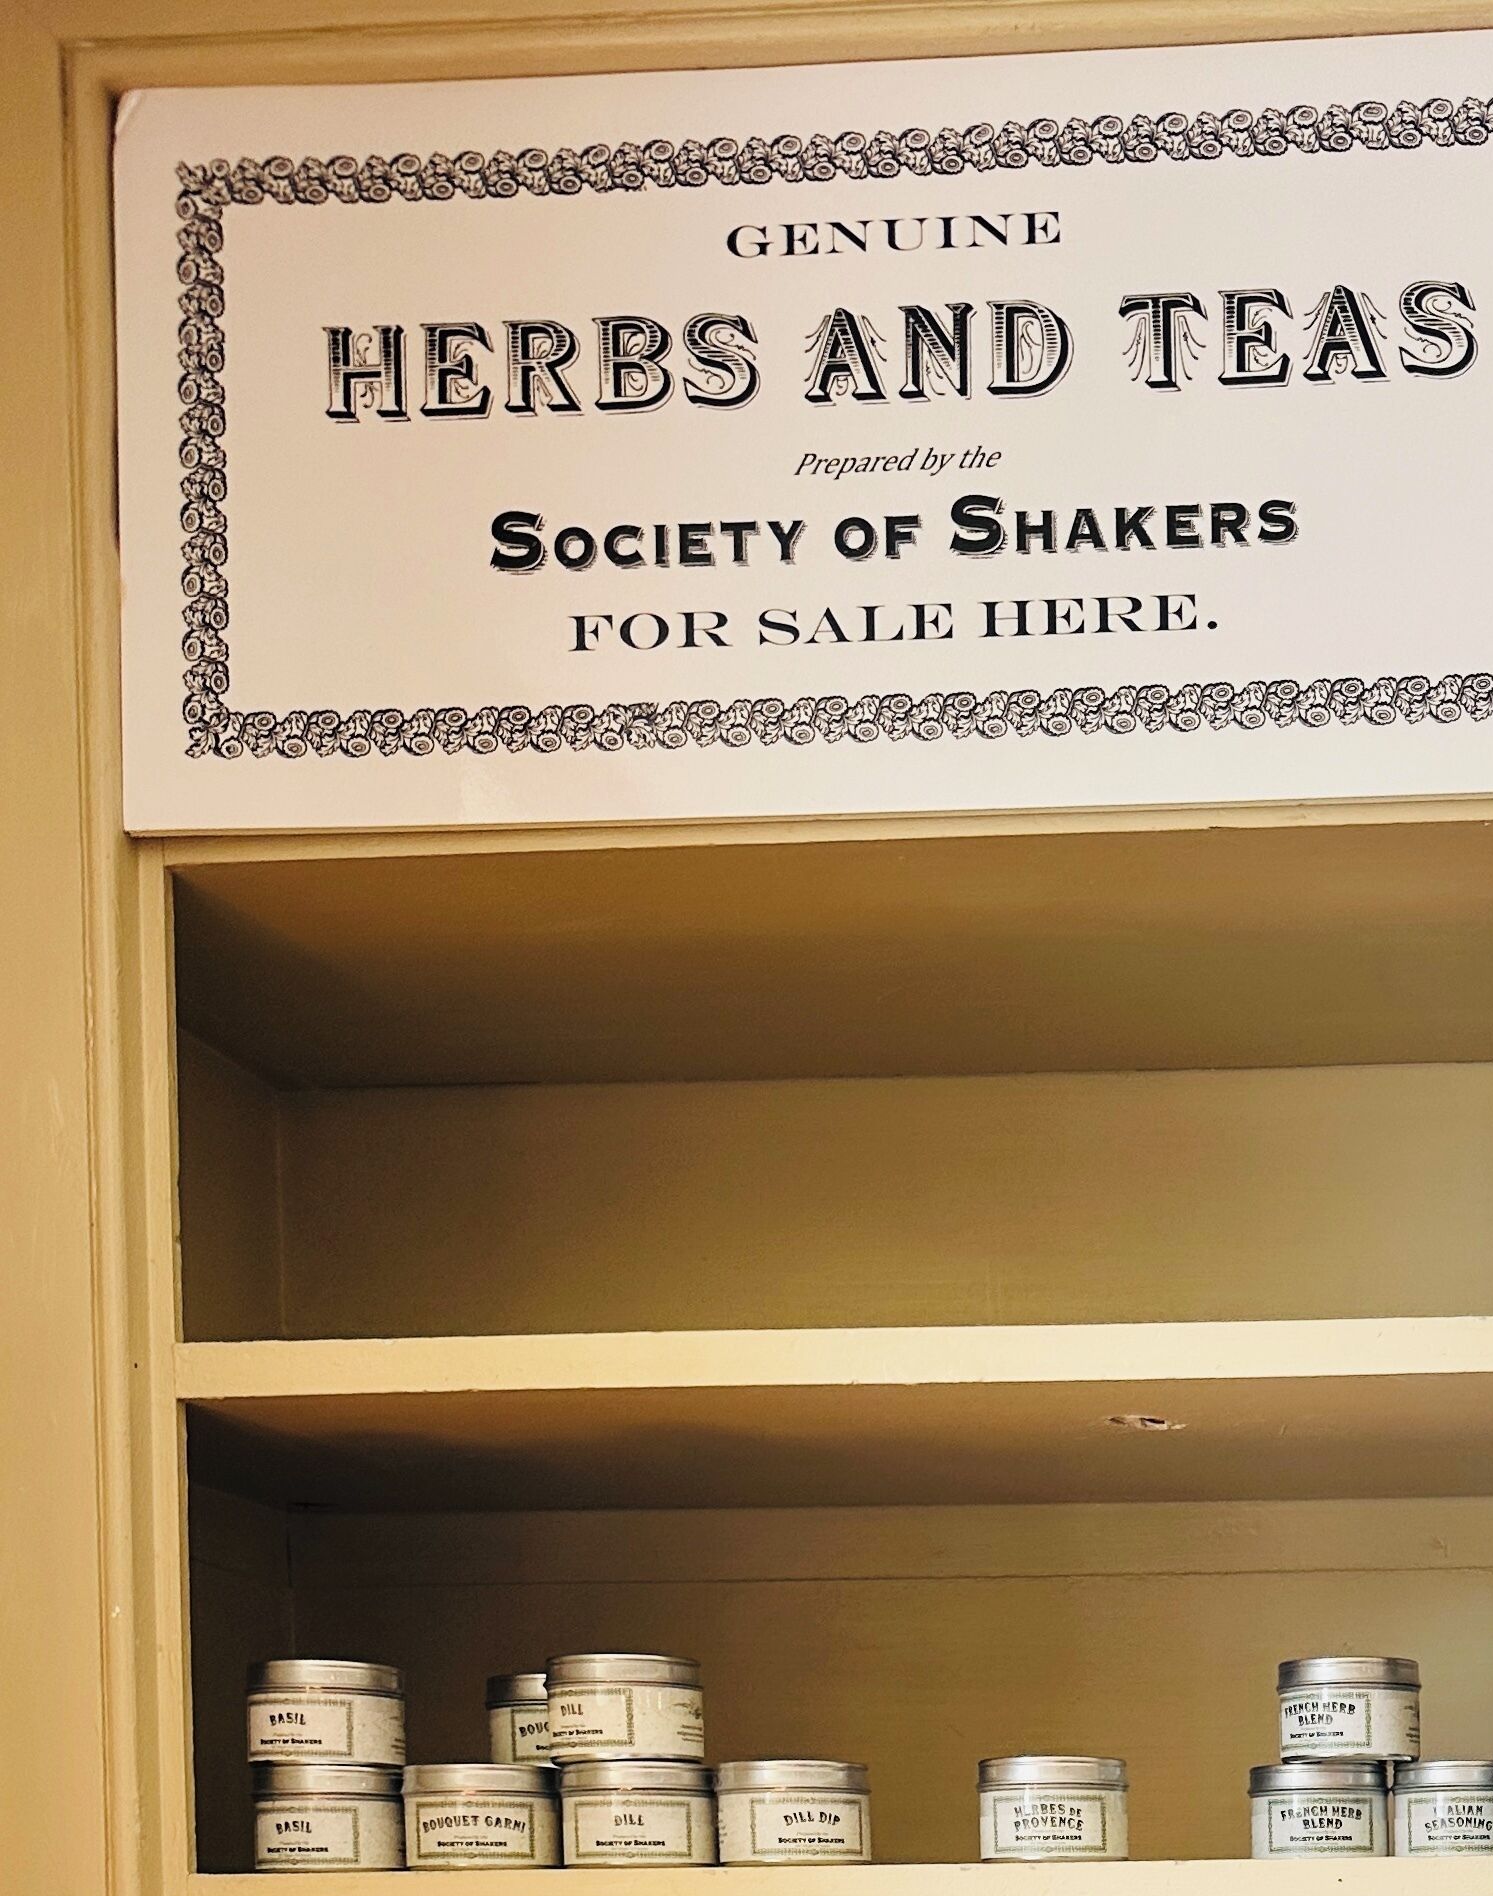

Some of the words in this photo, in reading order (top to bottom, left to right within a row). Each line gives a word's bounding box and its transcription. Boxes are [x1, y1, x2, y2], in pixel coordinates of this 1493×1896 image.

[727, 211, 1061, 258] GENUINE
[322, 312, 762, 423] HERBS
[803, 299, 1074, 405] AND
[1119, 280, 1478, 391] TEAS
[794, 447, 918, 480] Prepared
[919, 447, 956, 477] by
[958, 445, 1002, 470] the
[490, 511, 807, 575] SOCIETY
[834, 514, 921, 562] OF
[950, 494, 1299, 559] SHAKERS
[568, 612, 732, 653] FOR
[758, 603, 954, 648] SALE
[978, 594, 1219, 639] HERE.
[560, 1704, 584, 1717] DILL
[1284, 1702, 1319, 1719] FRENCH
[1322, 1702, 1356, 1715] HERB
[269, 1712, 307, 1726] BASIL
[1298, 1714, 1333, 1726] BLEND
[784, 1811, 815, 1826] DILL
[818, 1811, 841, 1826] DIP
[1069, 1807, 1082, 1817] DE
[1281, 1806, 1329, 1821] FRENCH
[1332, 1806, 1363, 1820] HERB
[276, 1820, 312, 1835] BASIL
[423, 1815, 479, 1834] BOUQUET
[485, 1815, 525, 1834] GARNI
[614, 1814, 645, 1827] DILL
[1014, 1816, 1084, 1832] PROVENCE
[1303, 1818, 1343, 1829] BLEND
[1425, 1817, 1493, 1832] SEASONING
